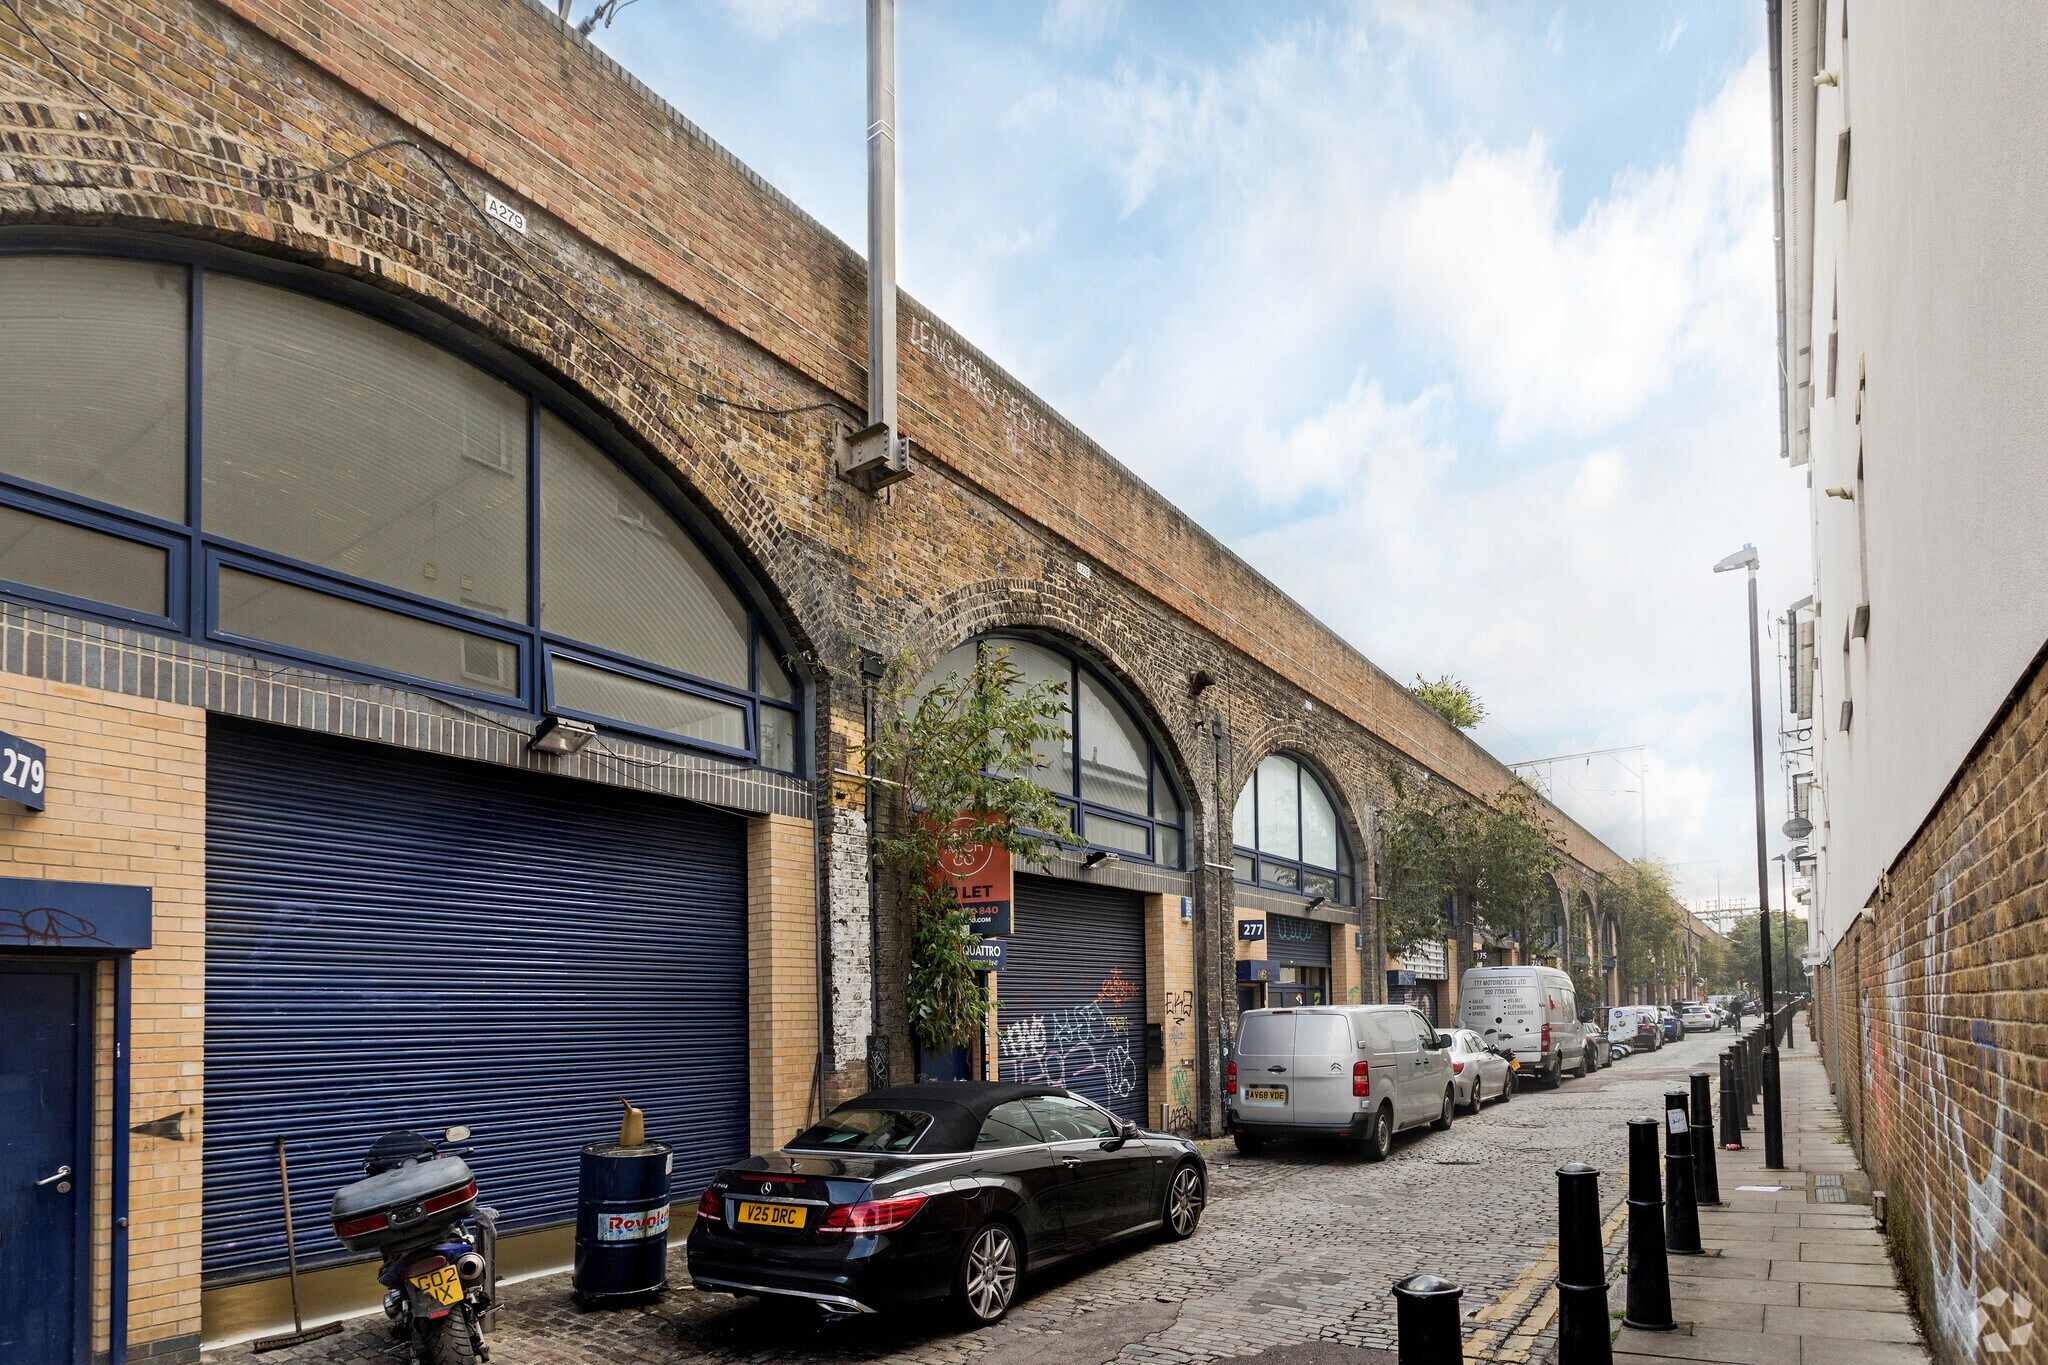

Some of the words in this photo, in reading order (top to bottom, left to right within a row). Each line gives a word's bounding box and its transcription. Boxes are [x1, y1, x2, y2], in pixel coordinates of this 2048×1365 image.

[490, 200, 523, 229] A279
[3, 748, 45, 794] 279
[962, 884, 993, 899] LET
[978, 905, 999, 915] 840
[1243, 924, 1263, 936] 277
[962, 945, 1001, 957] QUATTRO
[1249, 1091, 1268, 1099] AV68
[1270, 1091, 1284, 1100] VDE
[748, 1205, 769, 1222] V25
[771, 1207, 797, 1225] DRC
